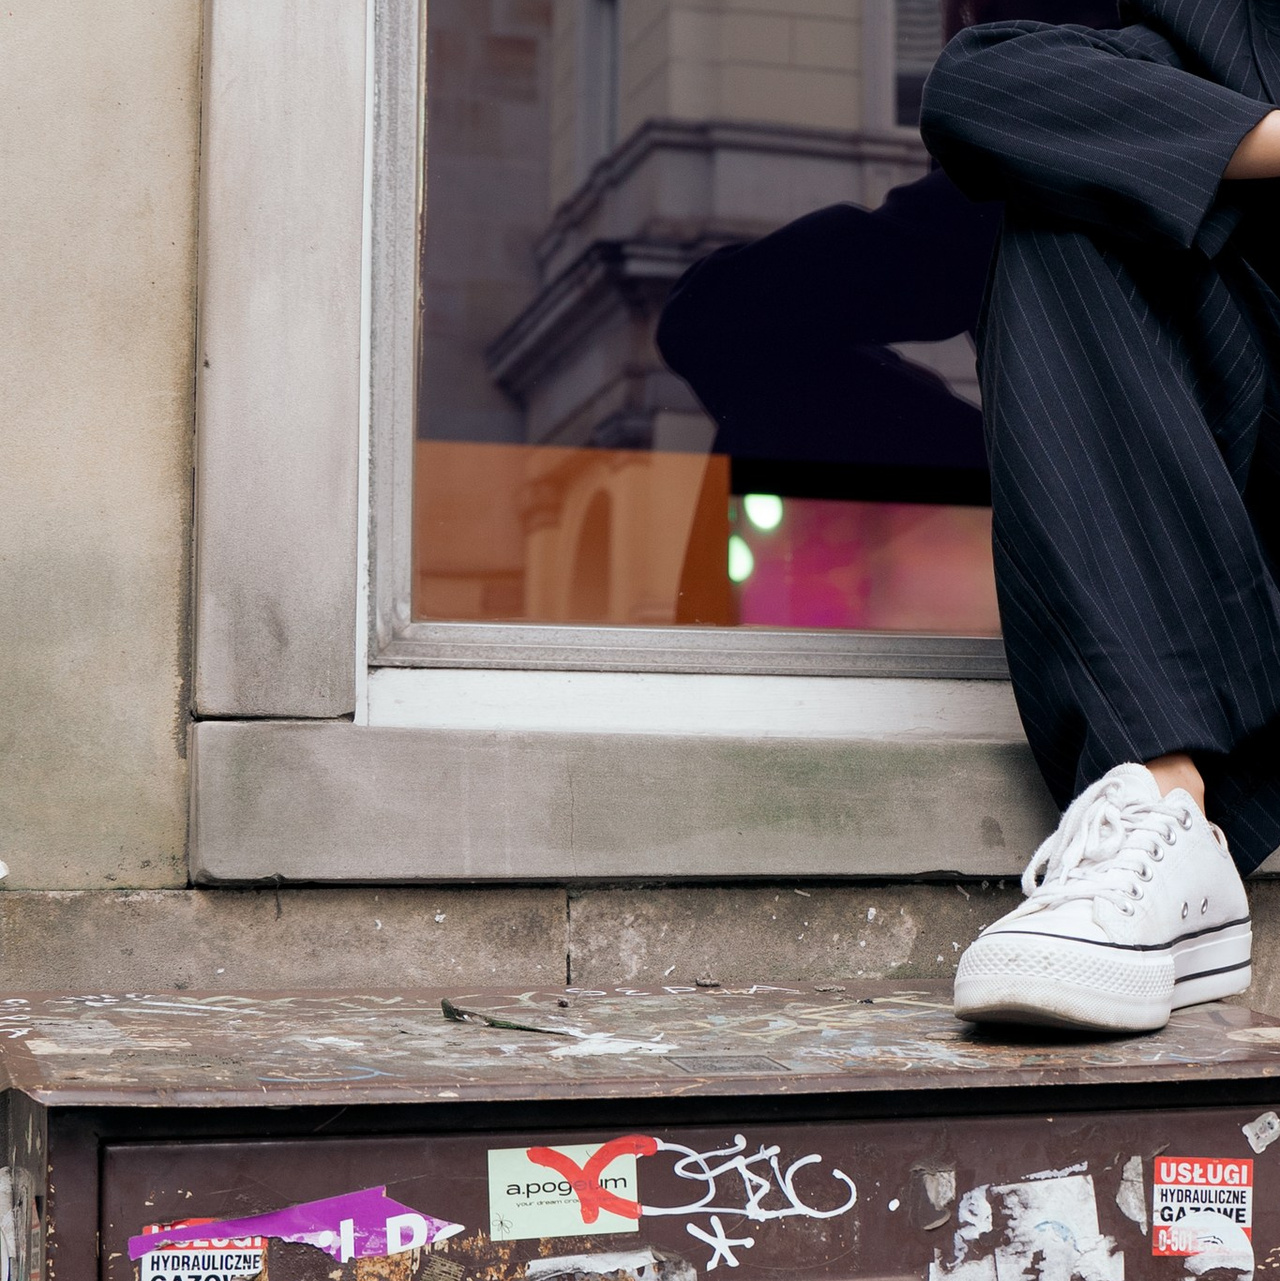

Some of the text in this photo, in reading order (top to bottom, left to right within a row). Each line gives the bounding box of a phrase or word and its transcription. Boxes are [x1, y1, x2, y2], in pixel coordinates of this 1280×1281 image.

[1160, 1162, 1248, 1185] USŁUGI
[1160, 1188, 1246, 1204] HYDRAULICZNE
[150, 1254, 260, 1271] HYDRAULICZNE
